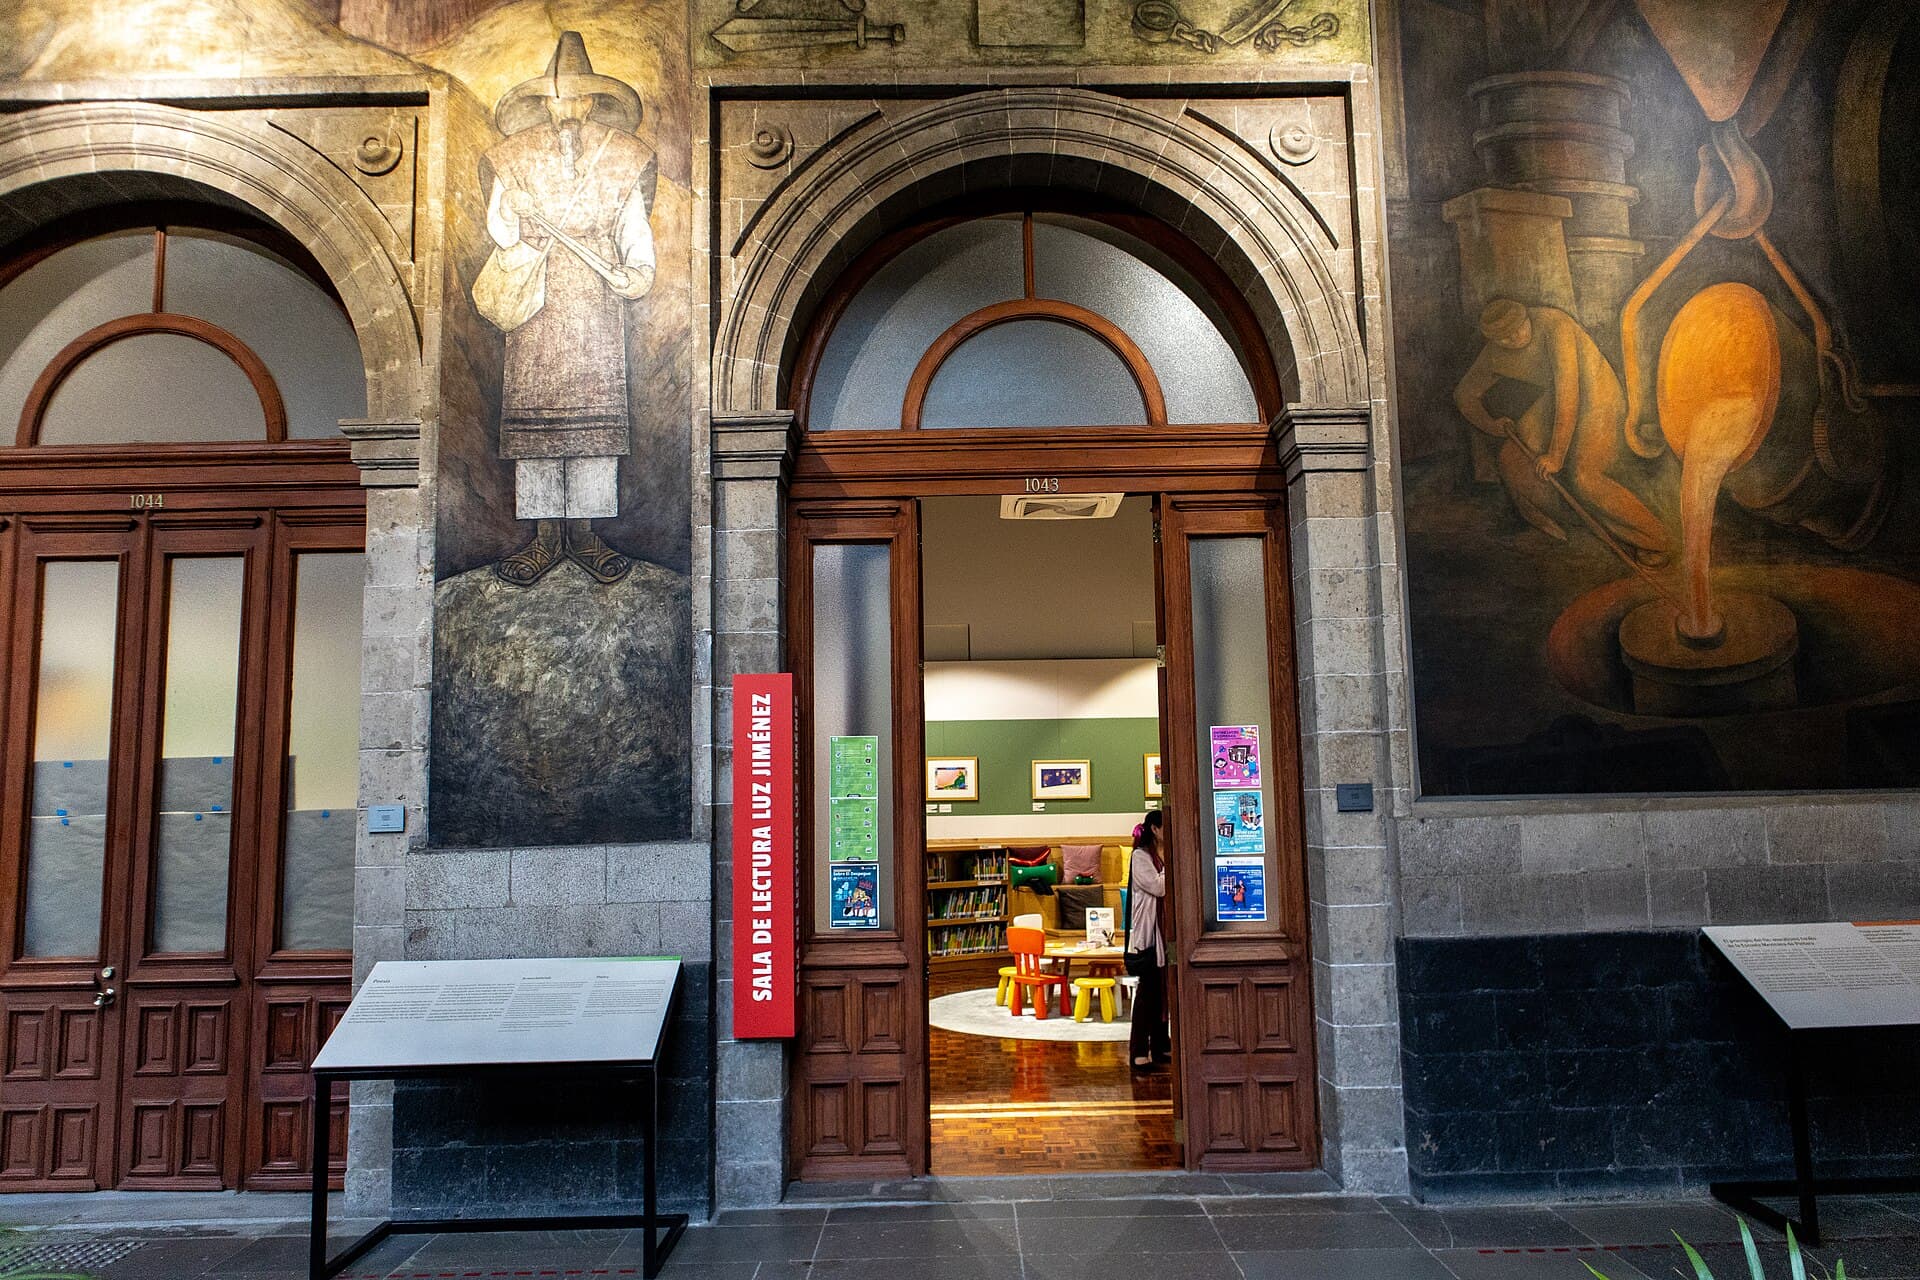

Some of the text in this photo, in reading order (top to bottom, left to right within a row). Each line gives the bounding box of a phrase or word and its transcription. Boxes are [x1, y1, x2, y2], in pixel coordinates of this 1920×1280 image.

[1025, 477, 1059, 491] 1043
[129, 494, 164, 509] 1044
[746, 693, 772, 1001] SALA DE LECTURA LUZ JIMÉNEZ
